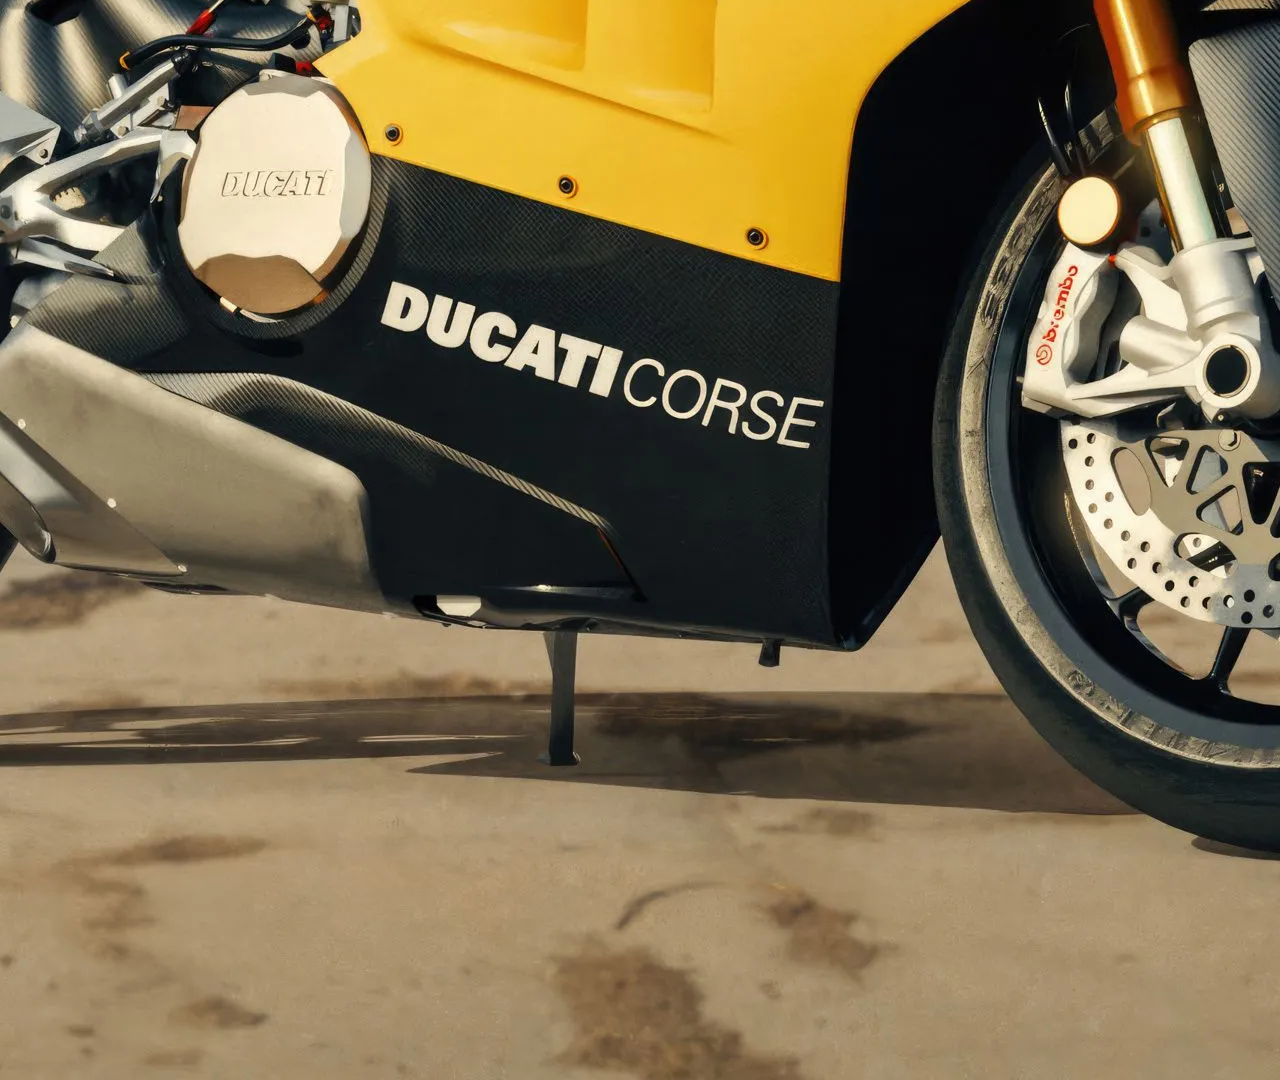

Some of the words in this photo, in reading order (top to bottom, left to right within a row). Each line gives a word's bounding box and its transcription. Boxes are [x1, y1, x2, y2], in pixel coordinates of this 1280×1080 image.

[220, 170, 333, 197] DUCATI
[1042, 264, 1079, 343] brembo
[380, 281, 624, 398] DUCATI
[624, 358, 824, 449] CORSE
